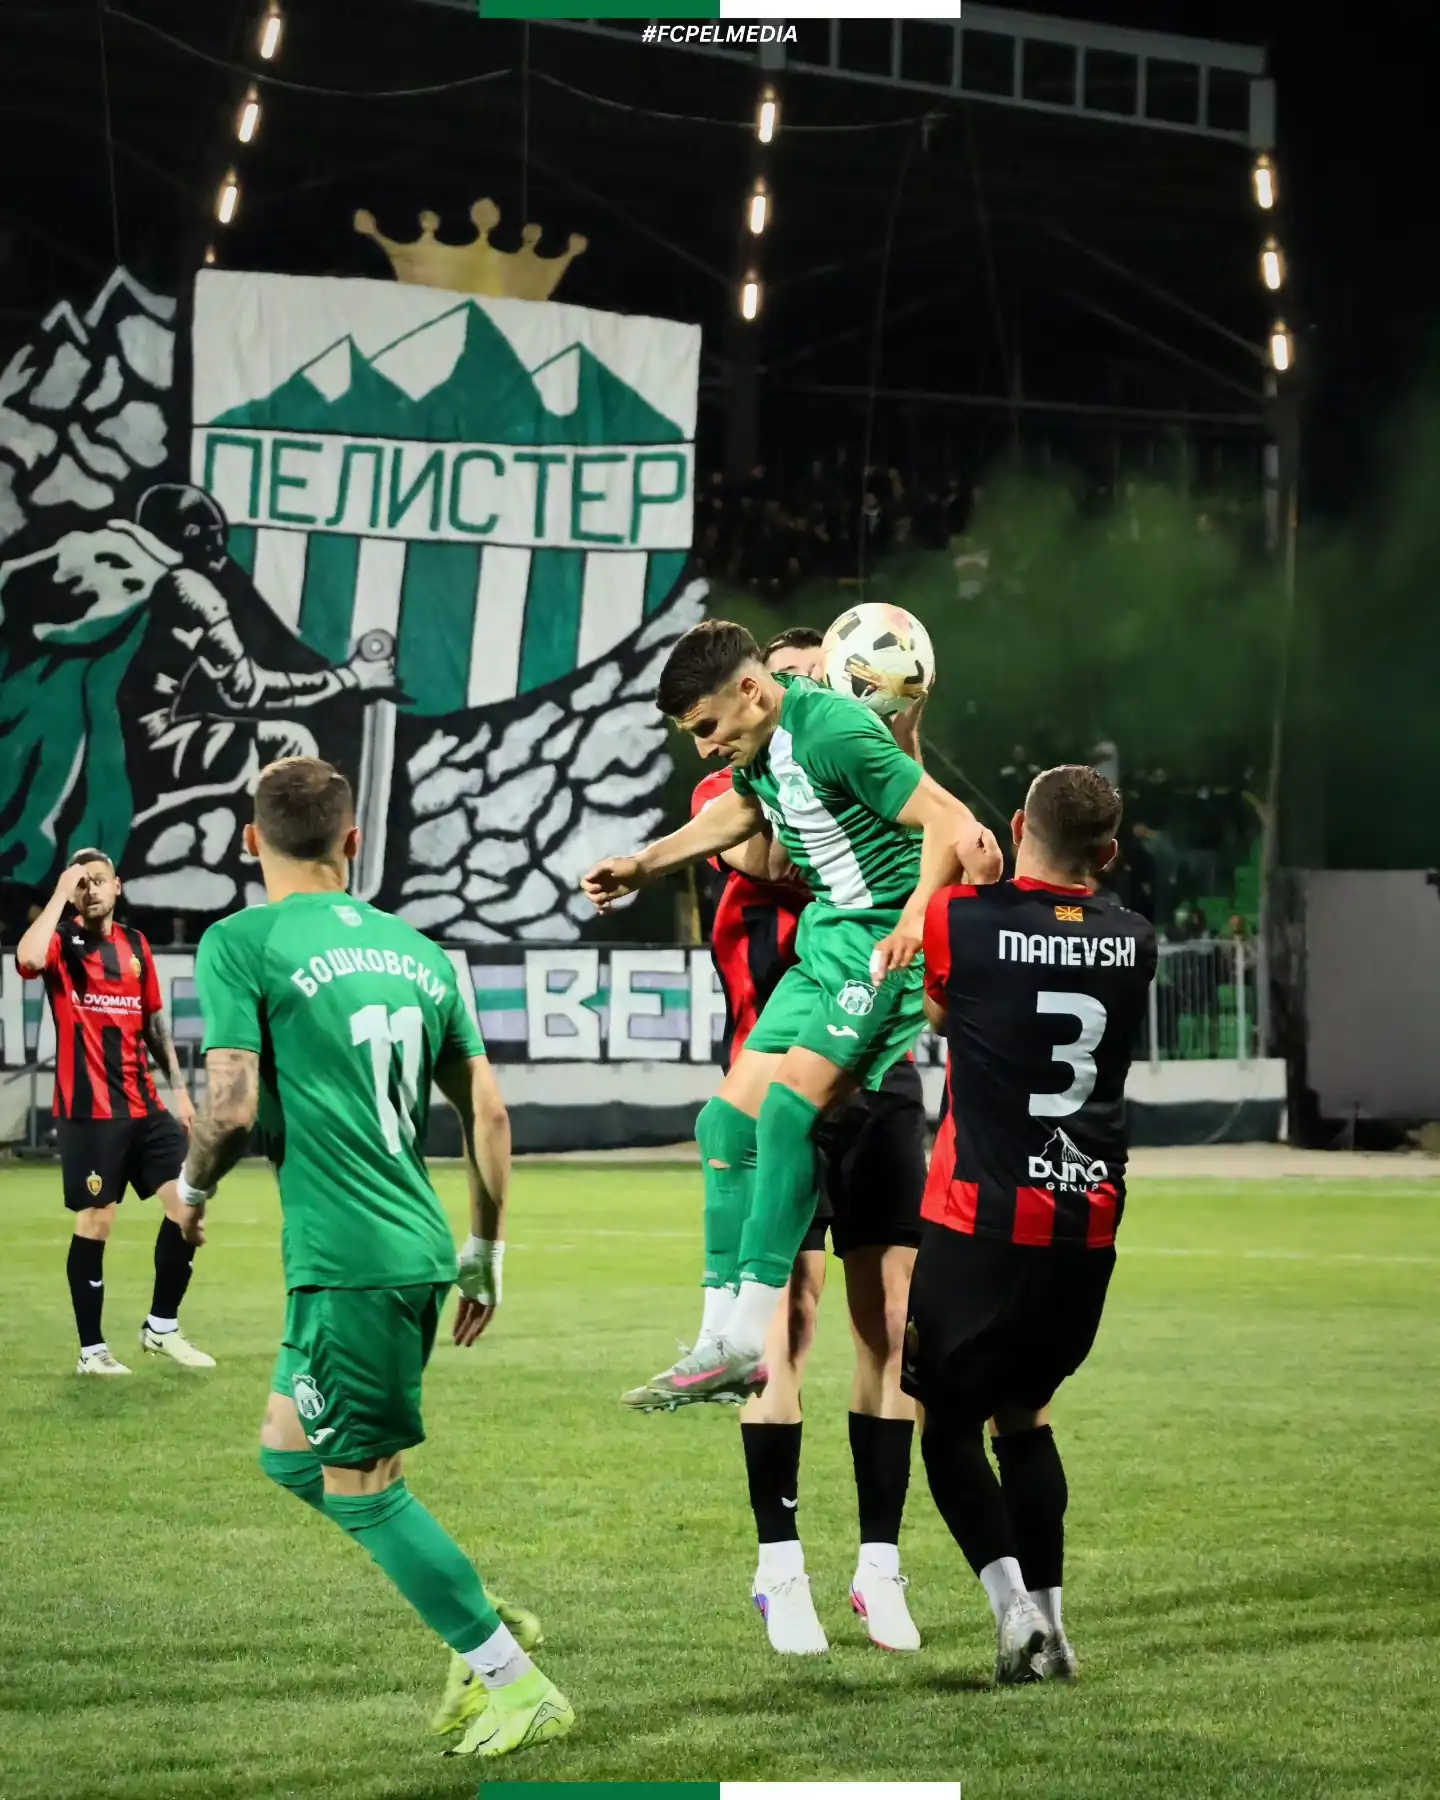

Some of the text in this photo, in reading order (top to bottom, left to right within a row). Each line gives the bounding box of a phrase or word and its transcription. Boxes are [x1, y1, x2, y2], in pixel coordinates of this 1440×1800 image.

[204, 433, 687, 544] ПЕЛИСТЕР
[291, 948, 446, 1005] БОШКОВСКИ
[999, 930, 1136, 967] MANEVSKI
[350, 1005, 423, 1154] 11
[1028, 991, 1107, 1117] 3
